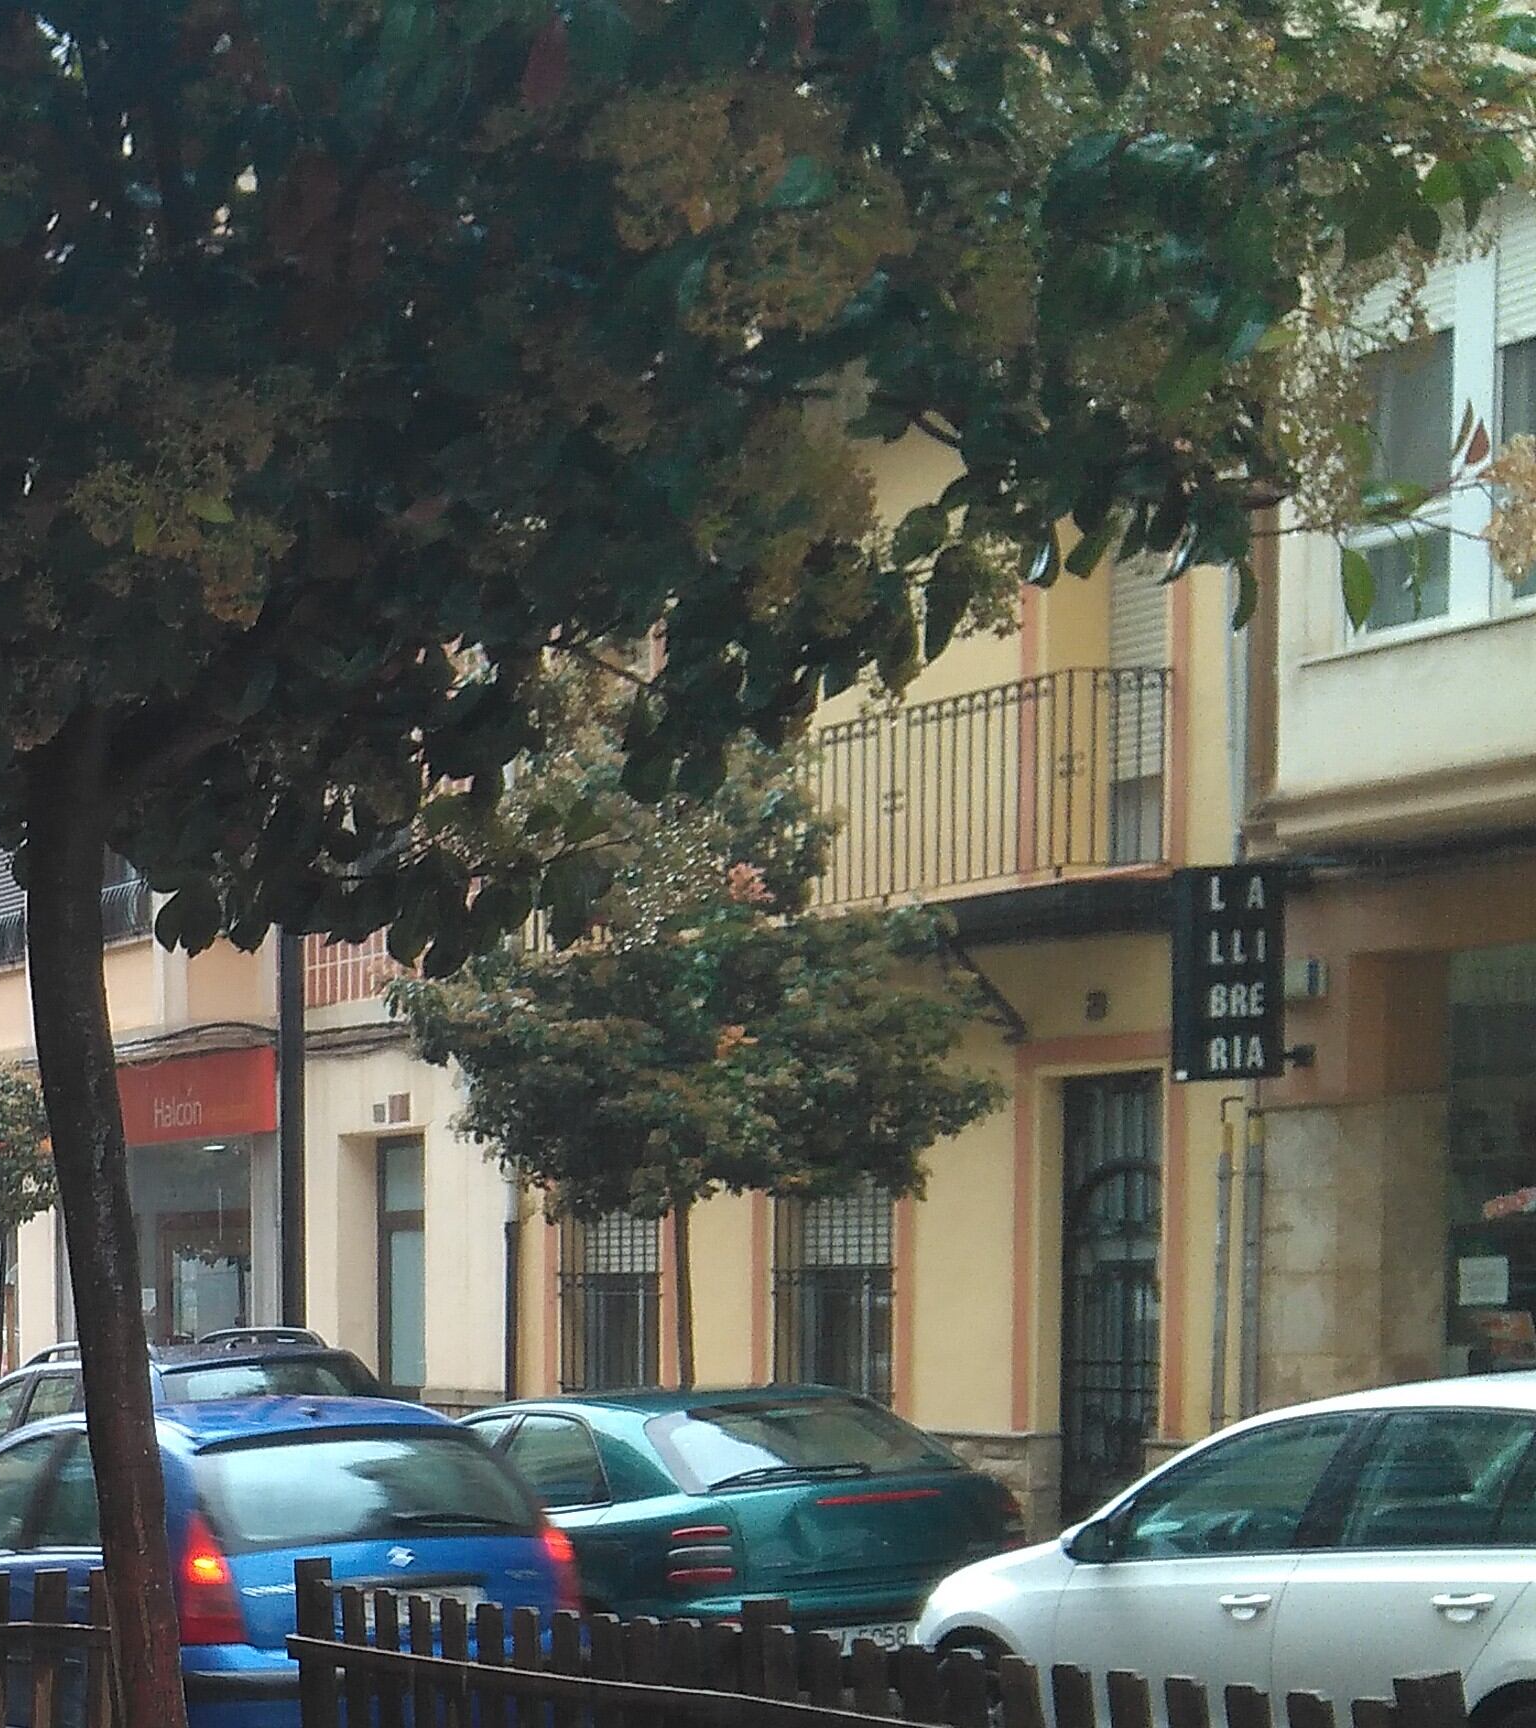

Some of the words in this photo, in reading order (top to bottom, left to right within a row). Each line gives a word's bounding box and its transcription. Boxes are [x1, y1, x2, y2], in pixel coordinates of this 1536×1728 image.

[1209, 928, 1267, 965] LLI
[1209, 982, 1266, 1019] BRE
[1209, 1035, 1266, 1072] RIA
[153, 1085, 203, 1129] Halcón
